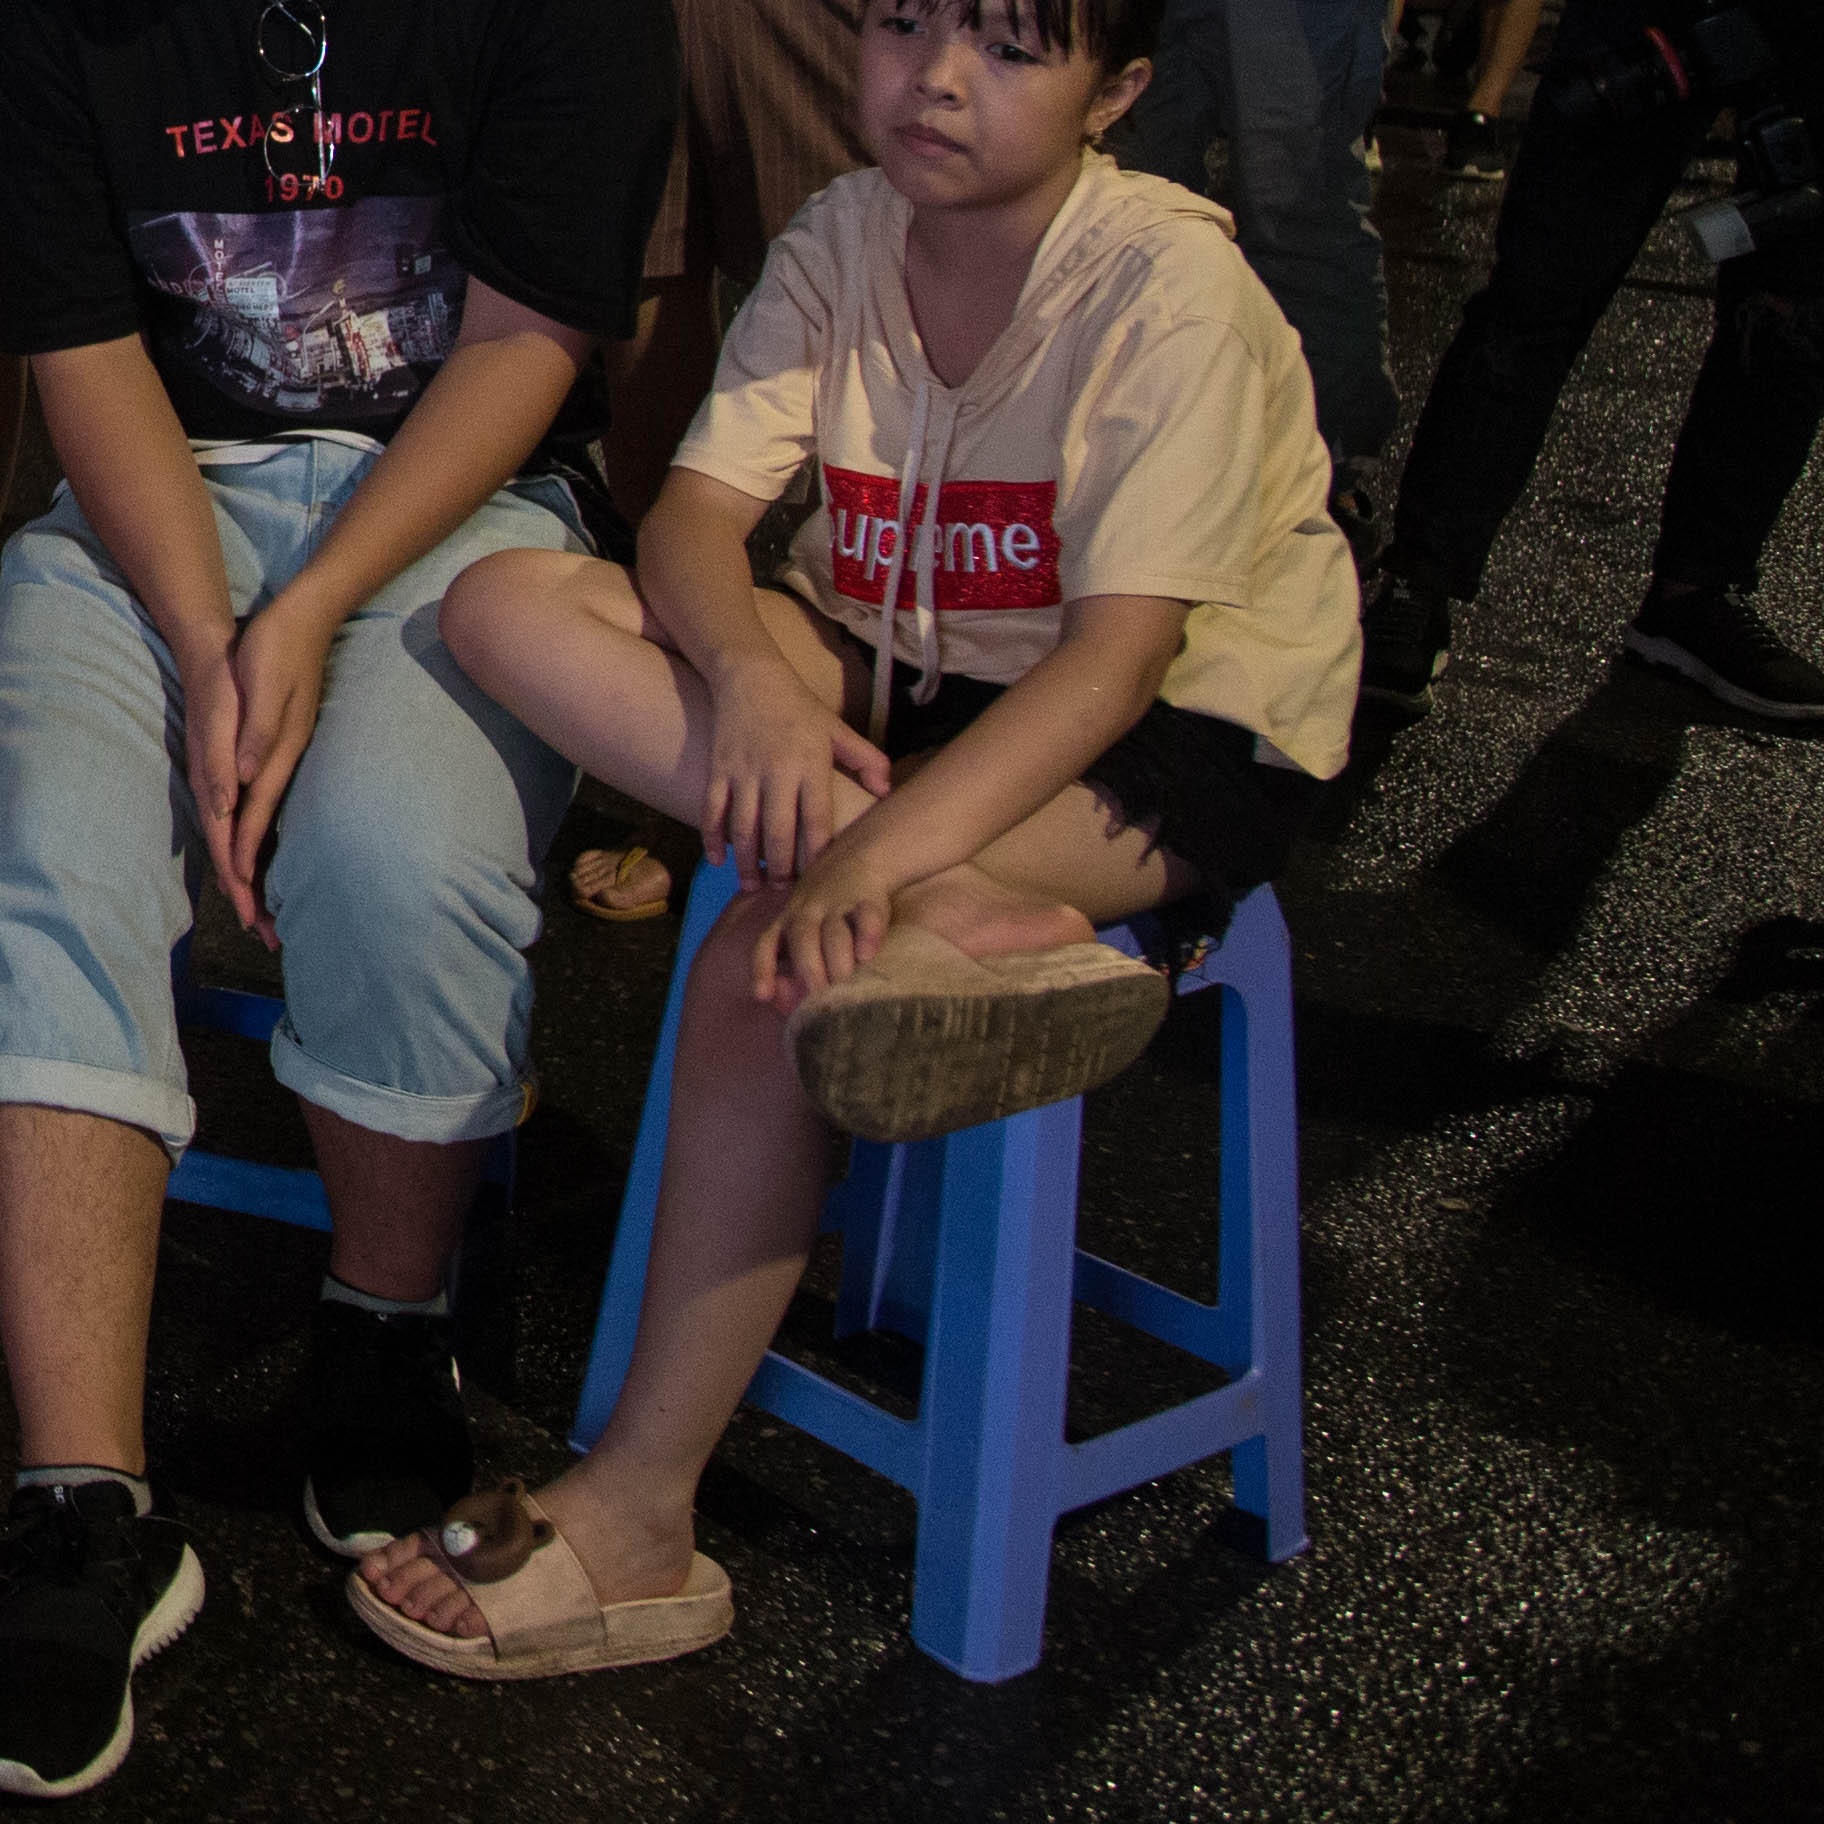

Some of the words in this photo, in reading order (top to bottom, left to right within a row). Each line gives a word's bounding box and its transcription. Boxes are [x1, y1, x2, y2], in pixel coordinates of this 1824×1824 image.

[165, 112, 295, 158] TEXAS
[313, 107, 439, 148] MOTEL
[264, 172, 345, 203] 1970
[830, 507, 1042, 581] upme
